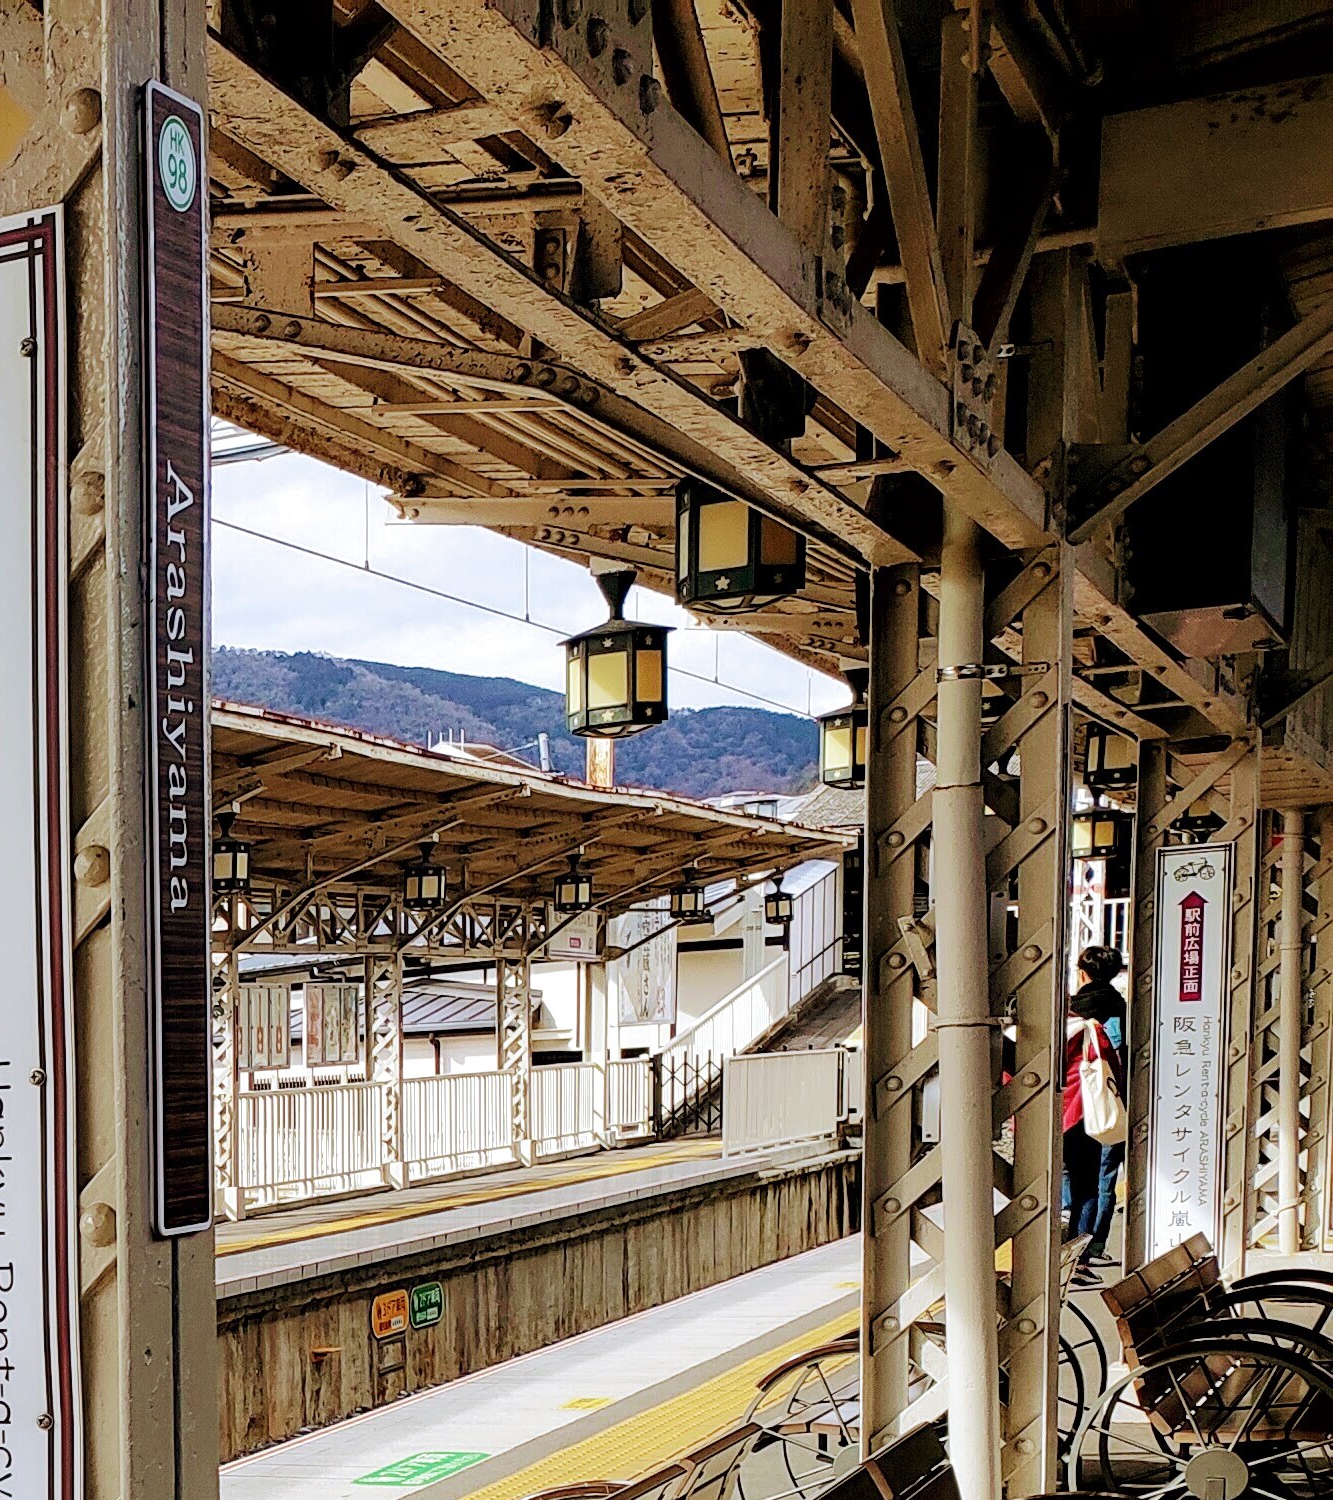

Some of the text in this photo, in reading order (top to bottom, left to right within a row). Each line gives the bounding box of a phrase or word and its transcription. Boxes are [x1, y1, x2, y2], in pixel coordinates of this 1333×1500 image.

[169, 127, 185, 156] HK
[167, 153, 188, 195] 98
[163, 459, 194, 914] Arashiyama
[1183, 907, 1201, 994] 駅前広場正面
[1200, 1015, 1213, 1057] Hankyu
[1197, 1131, 1209, 1207] ARASHIYAMA
